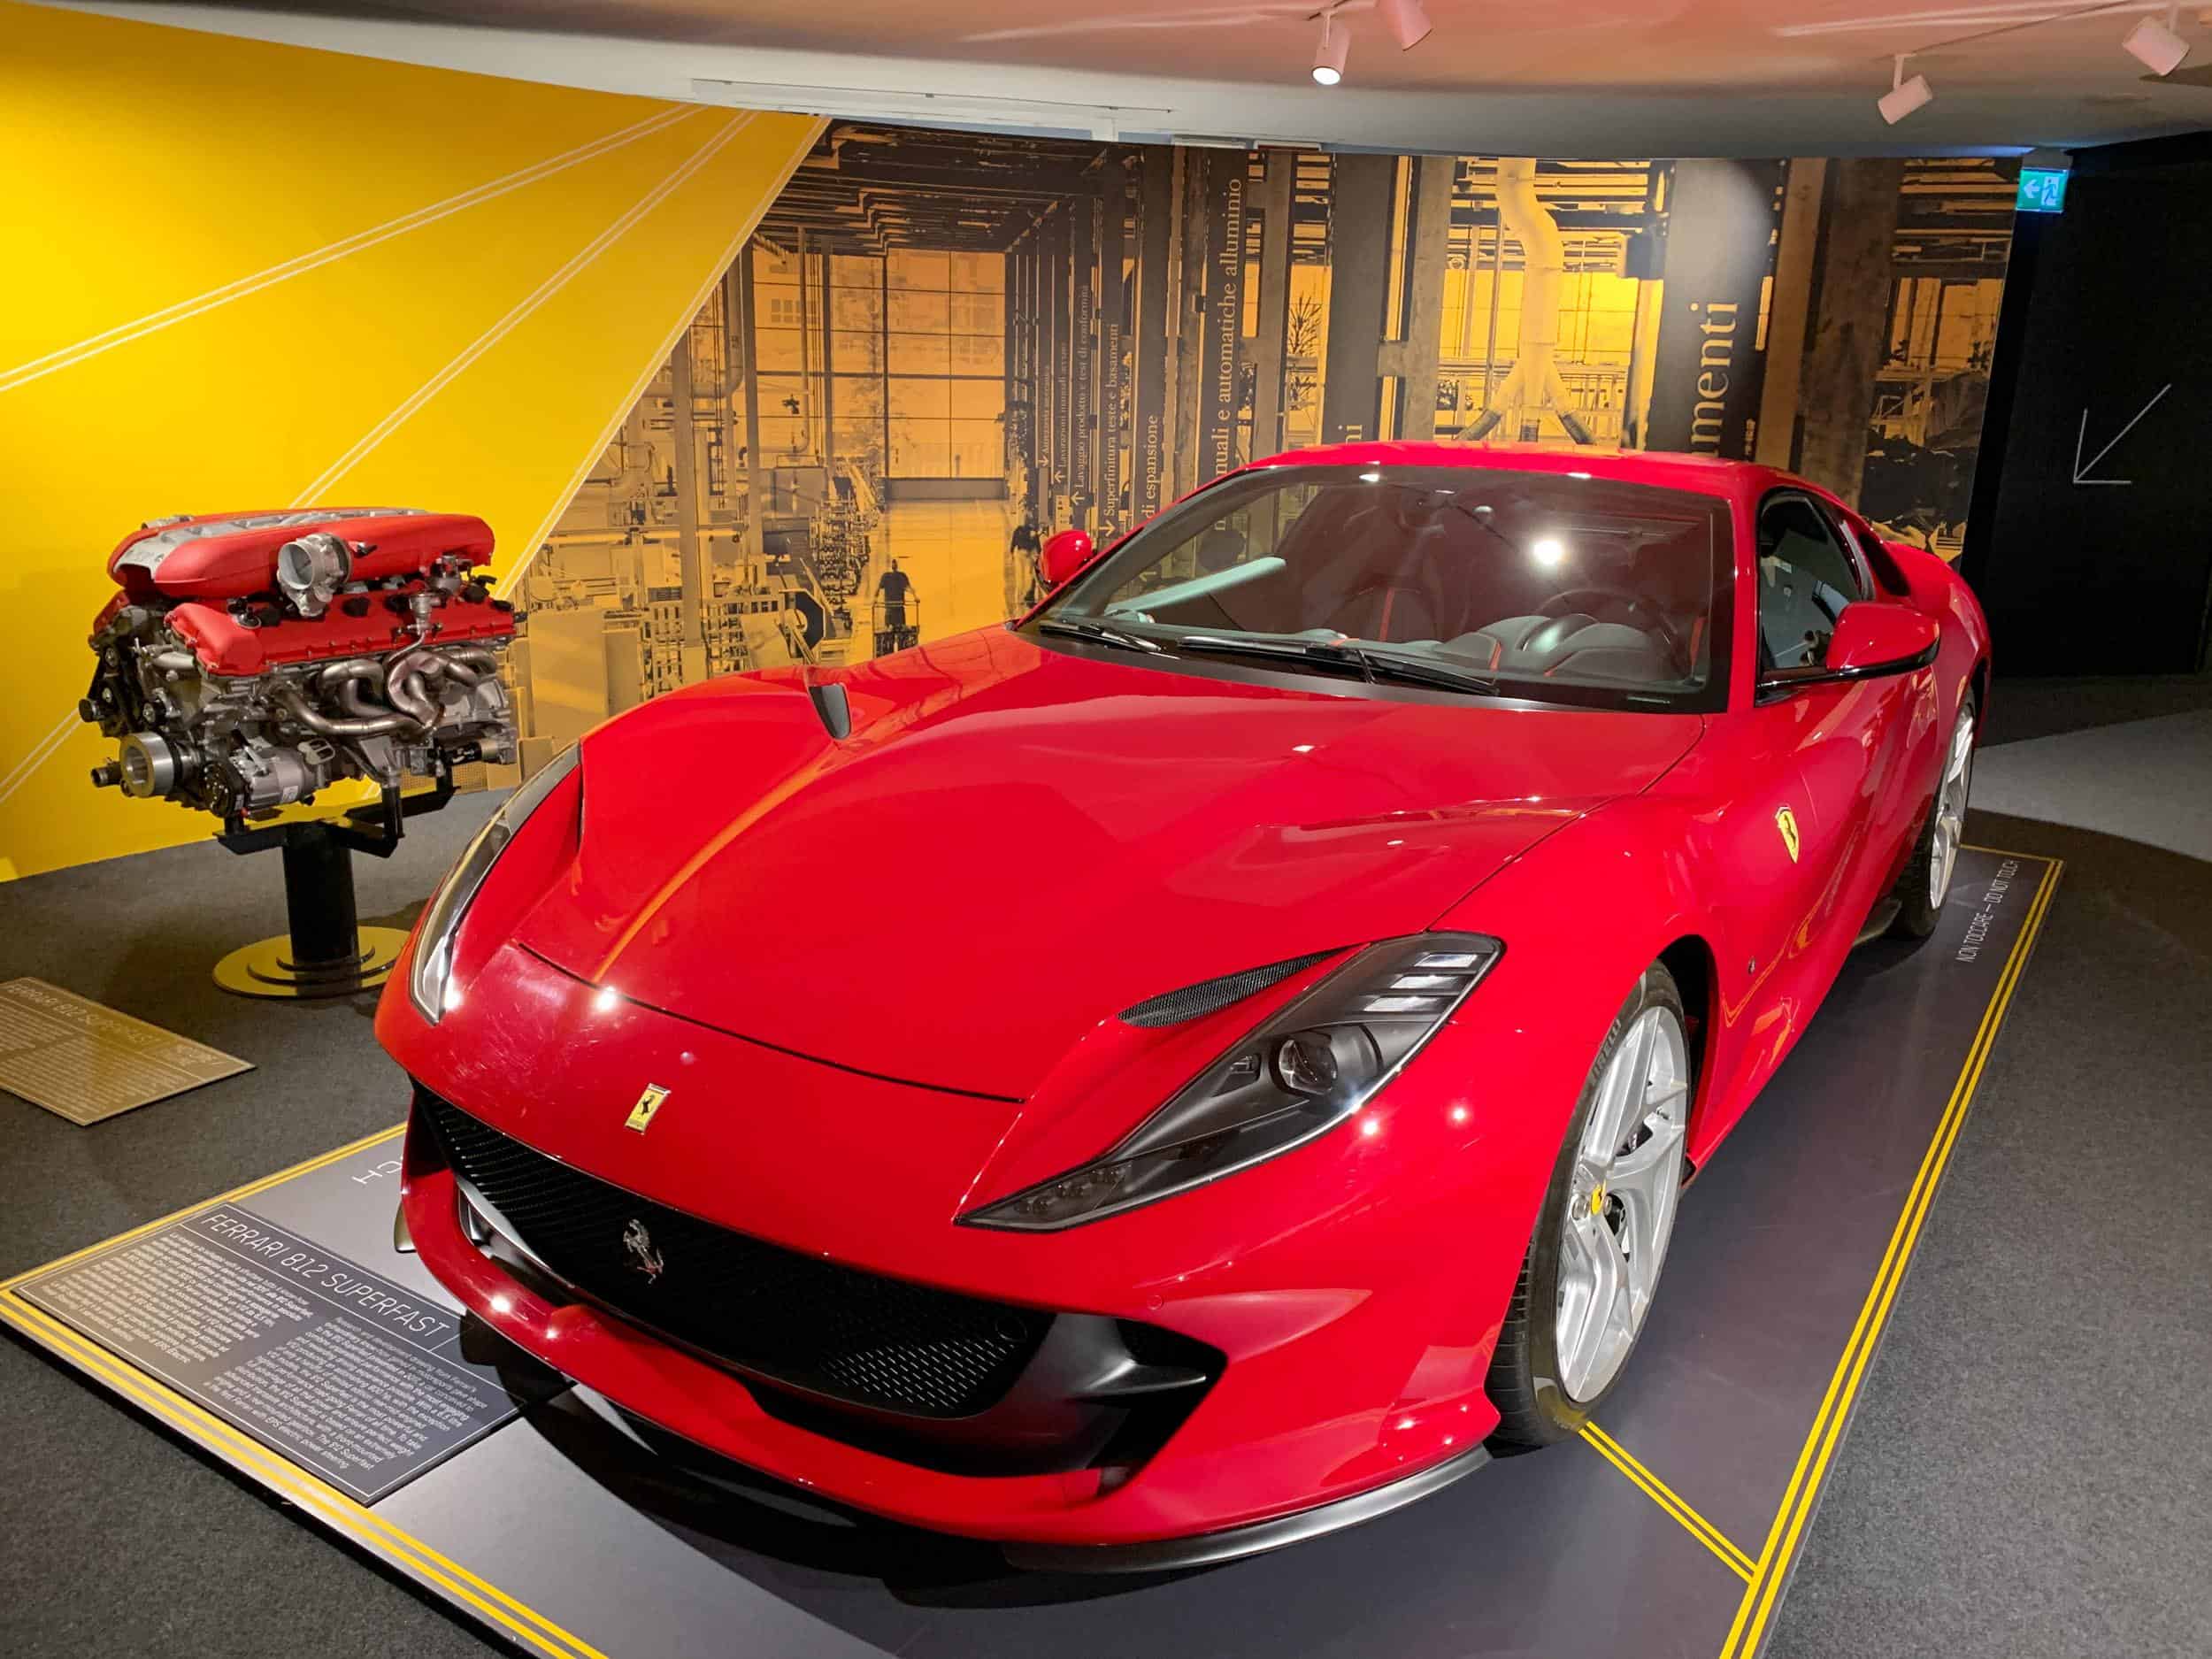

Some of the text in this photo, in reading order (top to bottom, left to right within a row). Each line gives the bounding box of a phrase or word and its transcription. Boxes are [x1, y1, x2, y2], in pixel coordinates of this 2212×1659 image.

[1221, 178, 1242, 277] alluminio
[1217, 283, 1239, 403] automatiche
[1106, 403, 1117, 433] teste
[1145, 415, 1159, 489] espansione
[1218, 410, 1231, 421] e
[1103, 437, 1118, 517] Superfinitura
[201, 1213, 289, 1259] FERRARI
[280, 1251, 329, 1279] 812
[320, 1272, 451, 1338] SUPERFAST
